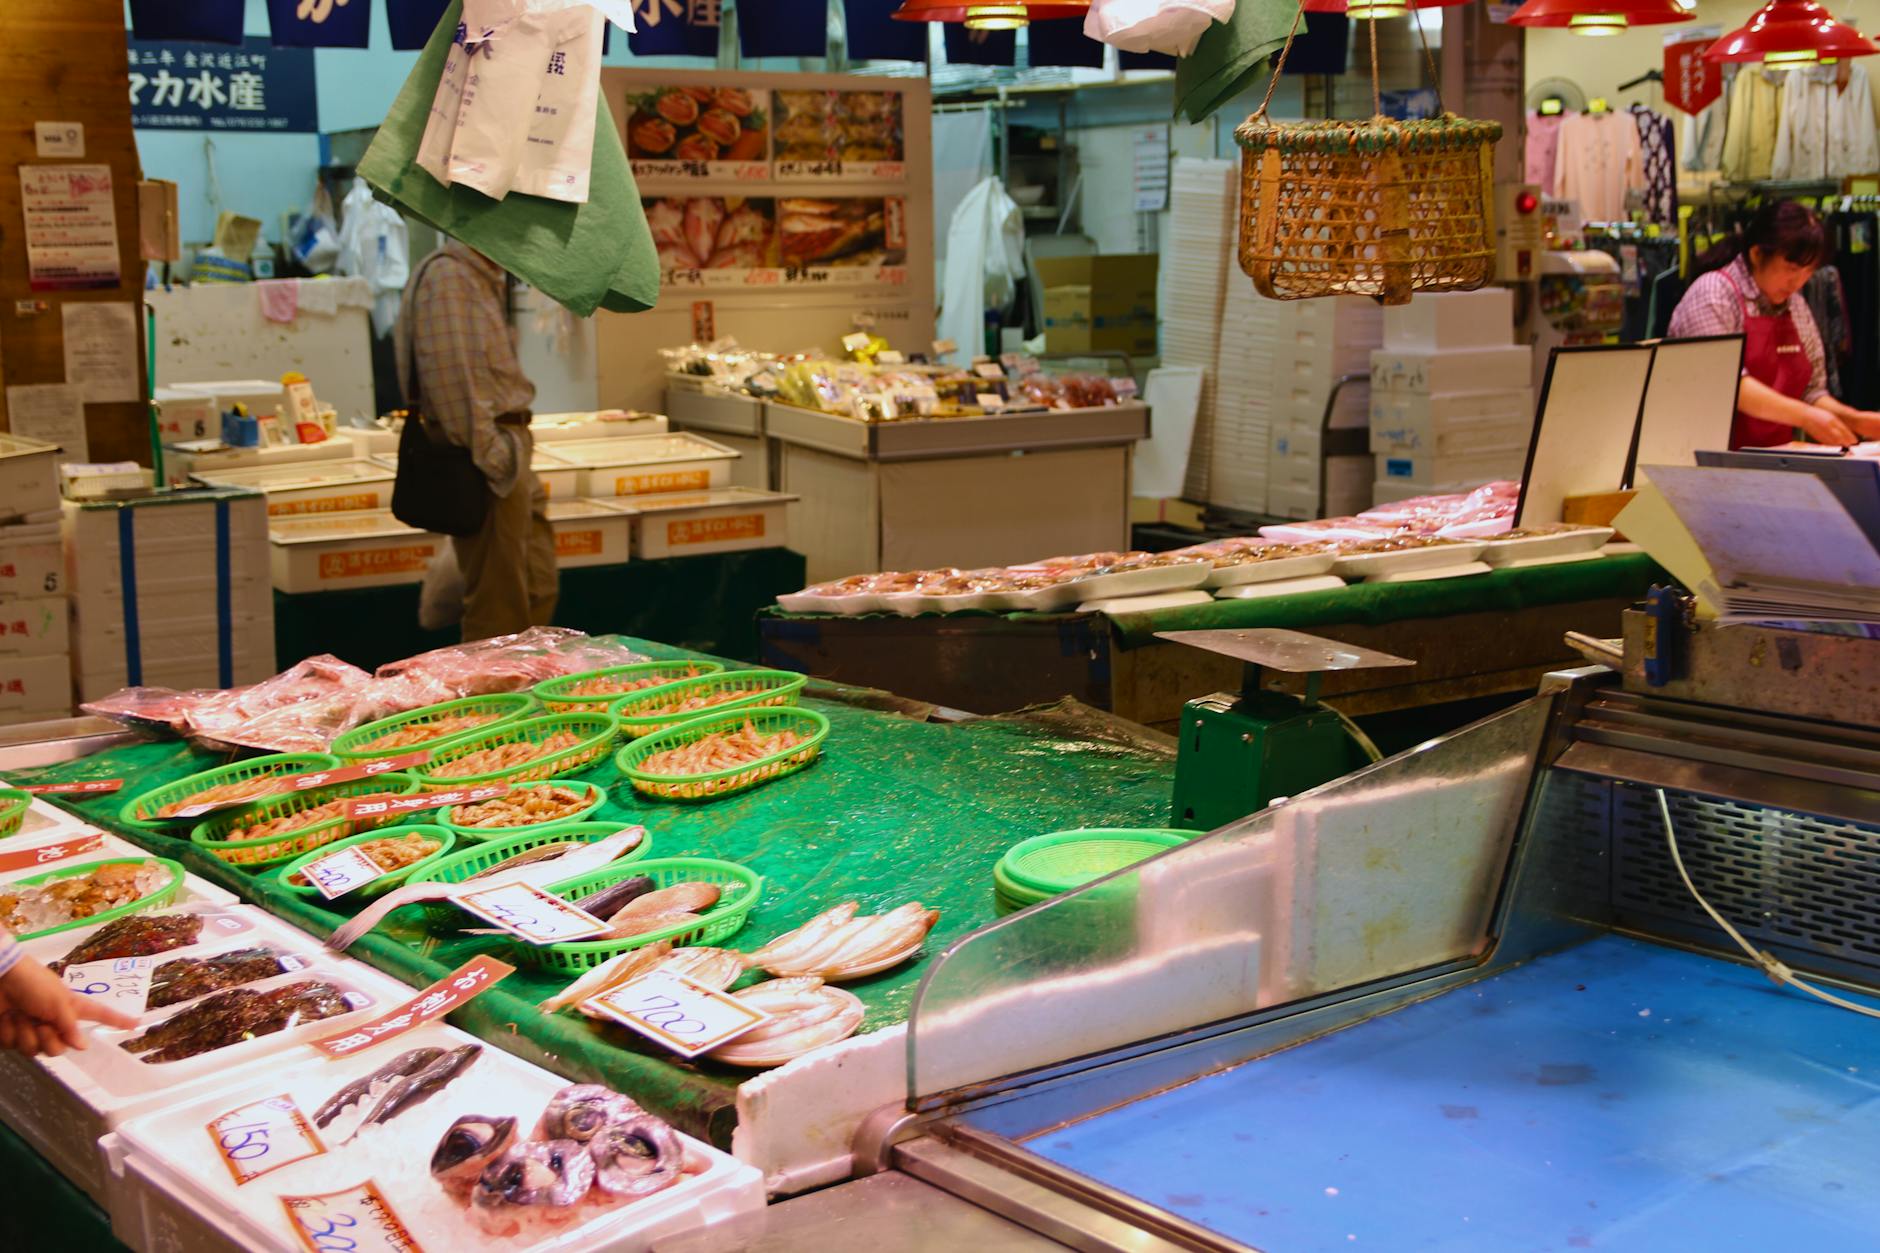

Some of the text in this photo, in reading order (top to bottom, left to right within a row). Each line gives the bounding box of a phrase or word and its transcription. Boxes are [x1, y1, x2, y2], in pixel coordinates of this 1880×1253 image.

[353, 786, 504, 816] お刺身用
[319, 865, 351, 886] 400
[324, 967, 489, 1055] お刺身用
[625, 995, 706, 1034] 700
[219, 1122, 269, 1160] 150
